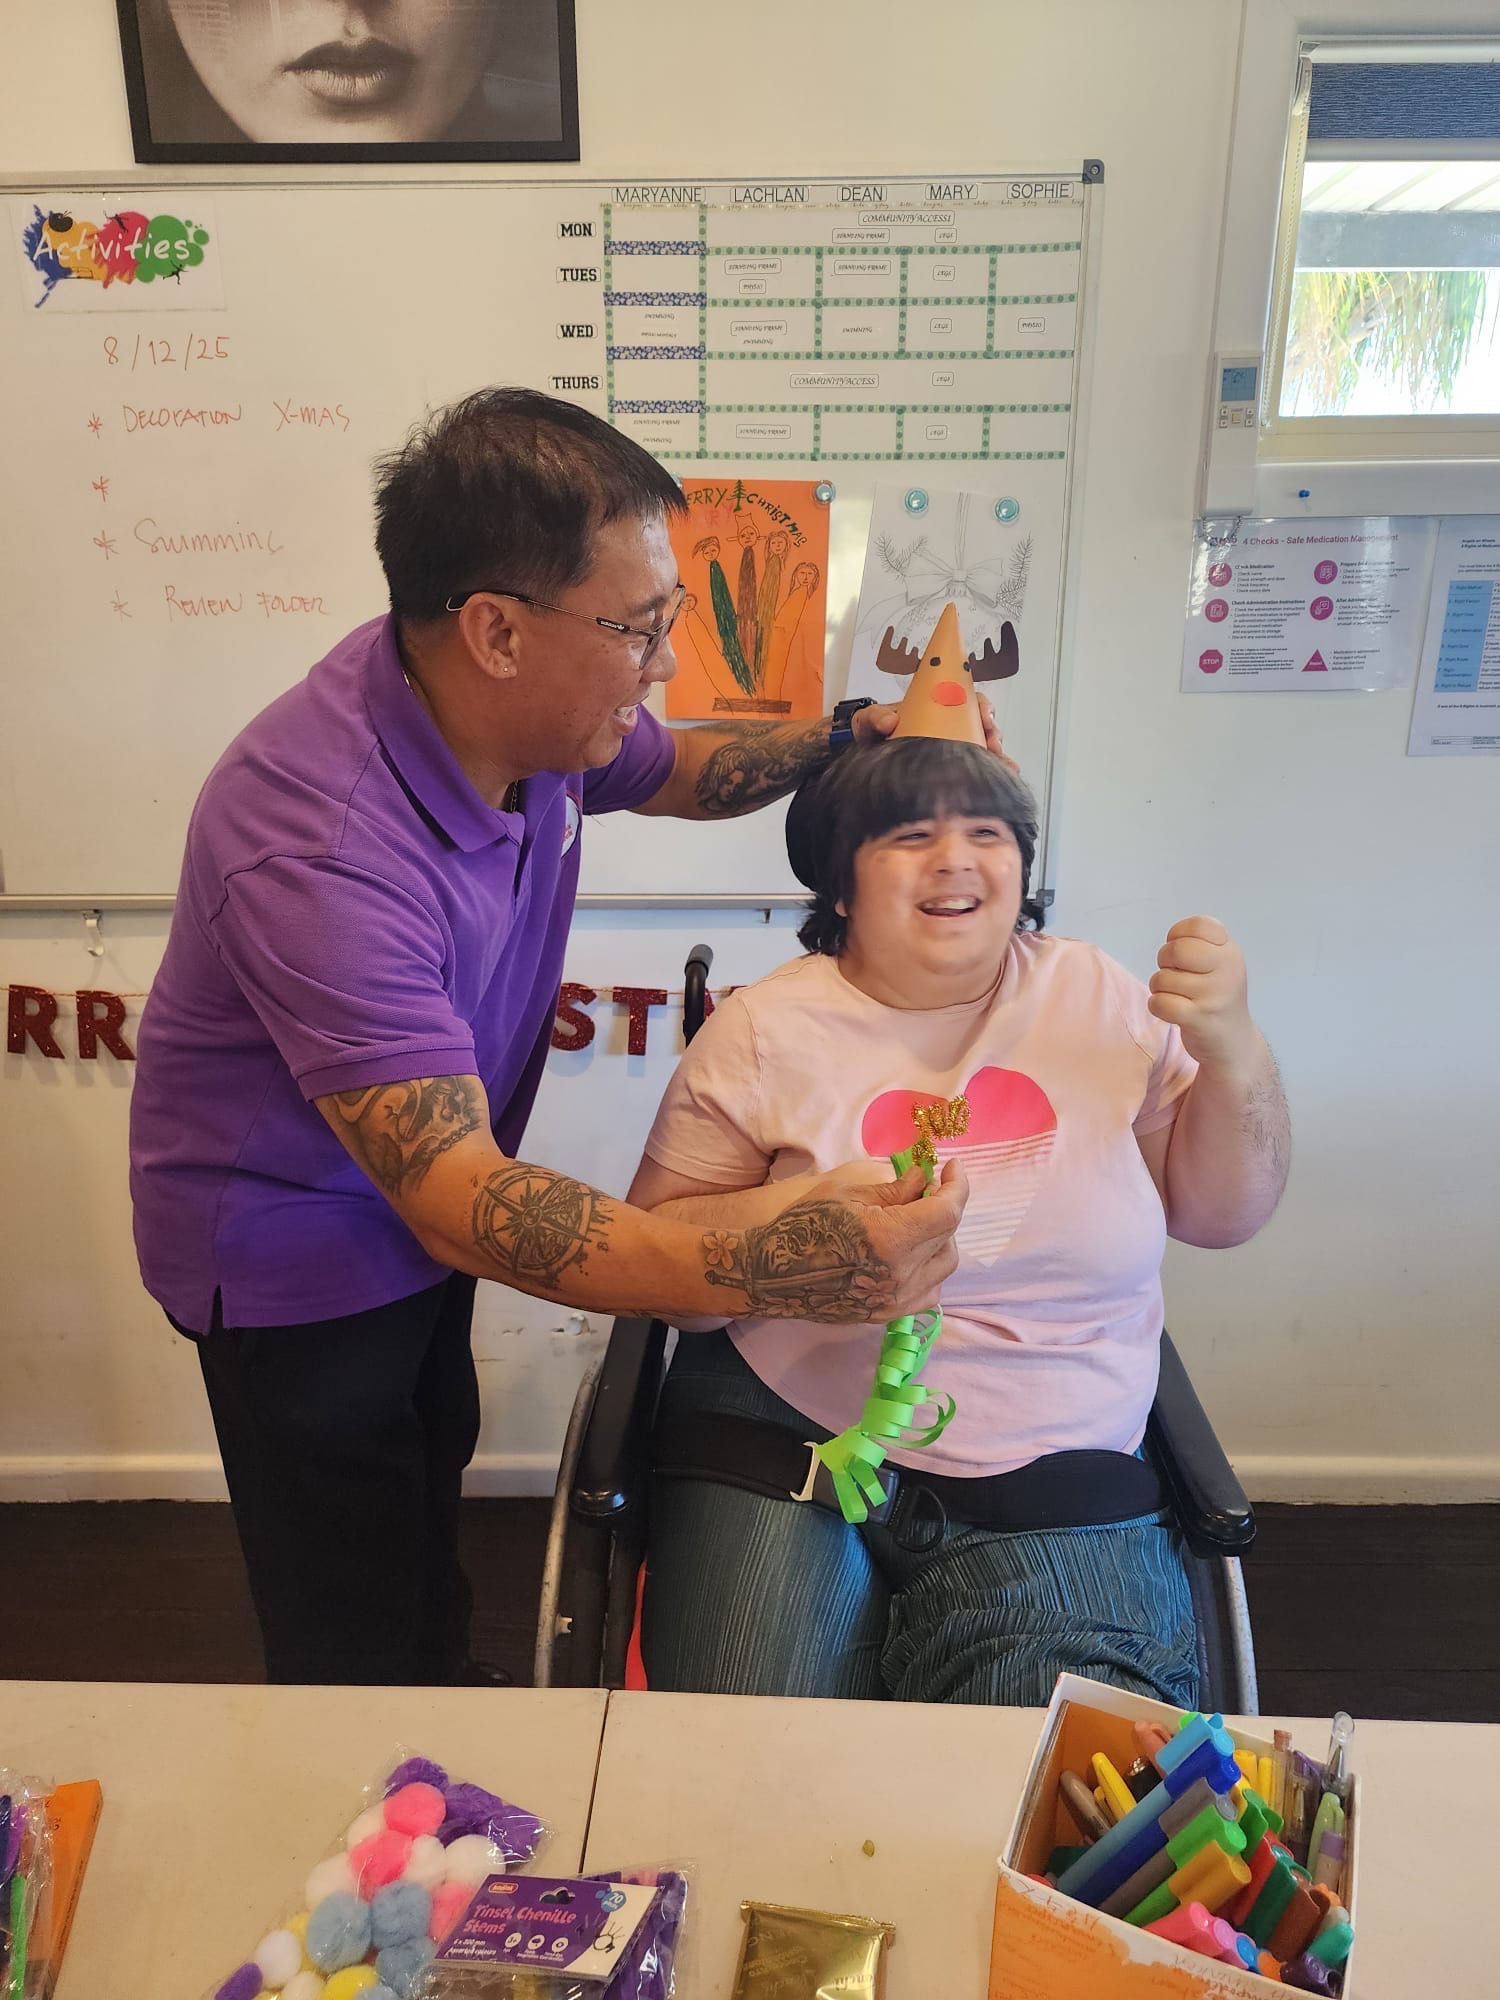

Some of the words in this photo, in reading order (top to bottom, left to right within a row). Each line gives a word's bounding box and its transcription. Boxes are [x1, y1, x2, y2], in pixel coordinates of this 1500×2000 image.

[616, 187, 701, 203] MARYANNE
[734, 187, 805, 203] LACHLAN
[841, 186, 883, 201] DEAN
[930, 185, 974, 199] MARY
[1011, 183, 1070, 198] SOPHIE
[560, 223, 592, 237] MON
[33, 227, 191, 260] Activities
[560, 268, 598, 282] TUES
[560, 324, 594, 338] WED
[552, 376, 599, 389] THURS
[1250, 538, 1279, 546] Checks
[1287, 536, 1305, 544] Safe
[1307, 535, 1349, 544] Medication
[473, 1904, 515, 1919] Tinsel
[517, 1907, 577, 1924] Chenille
[463, 1919, 507, 1934] Stems
